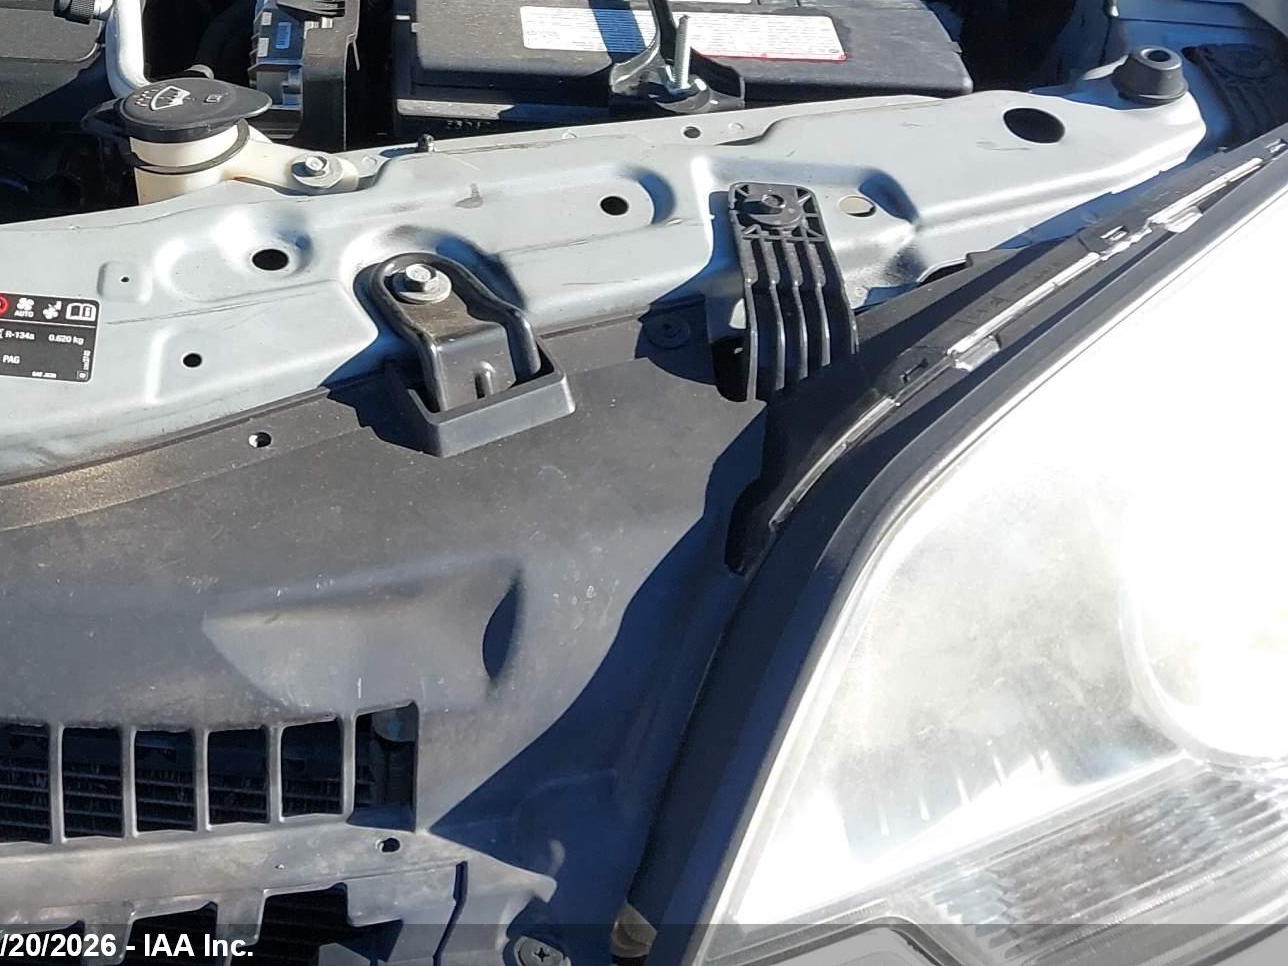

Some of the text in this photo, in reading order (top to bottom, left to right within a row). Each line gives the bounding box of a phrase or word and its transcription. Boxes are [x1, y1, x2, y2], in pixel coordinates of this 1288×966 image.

[14, 309, 34, 318] AUTO
[5, 330, 35, 341] R-134a
[73, 336, 85, 346] kg
[2, 354, 21, 365] PAG
